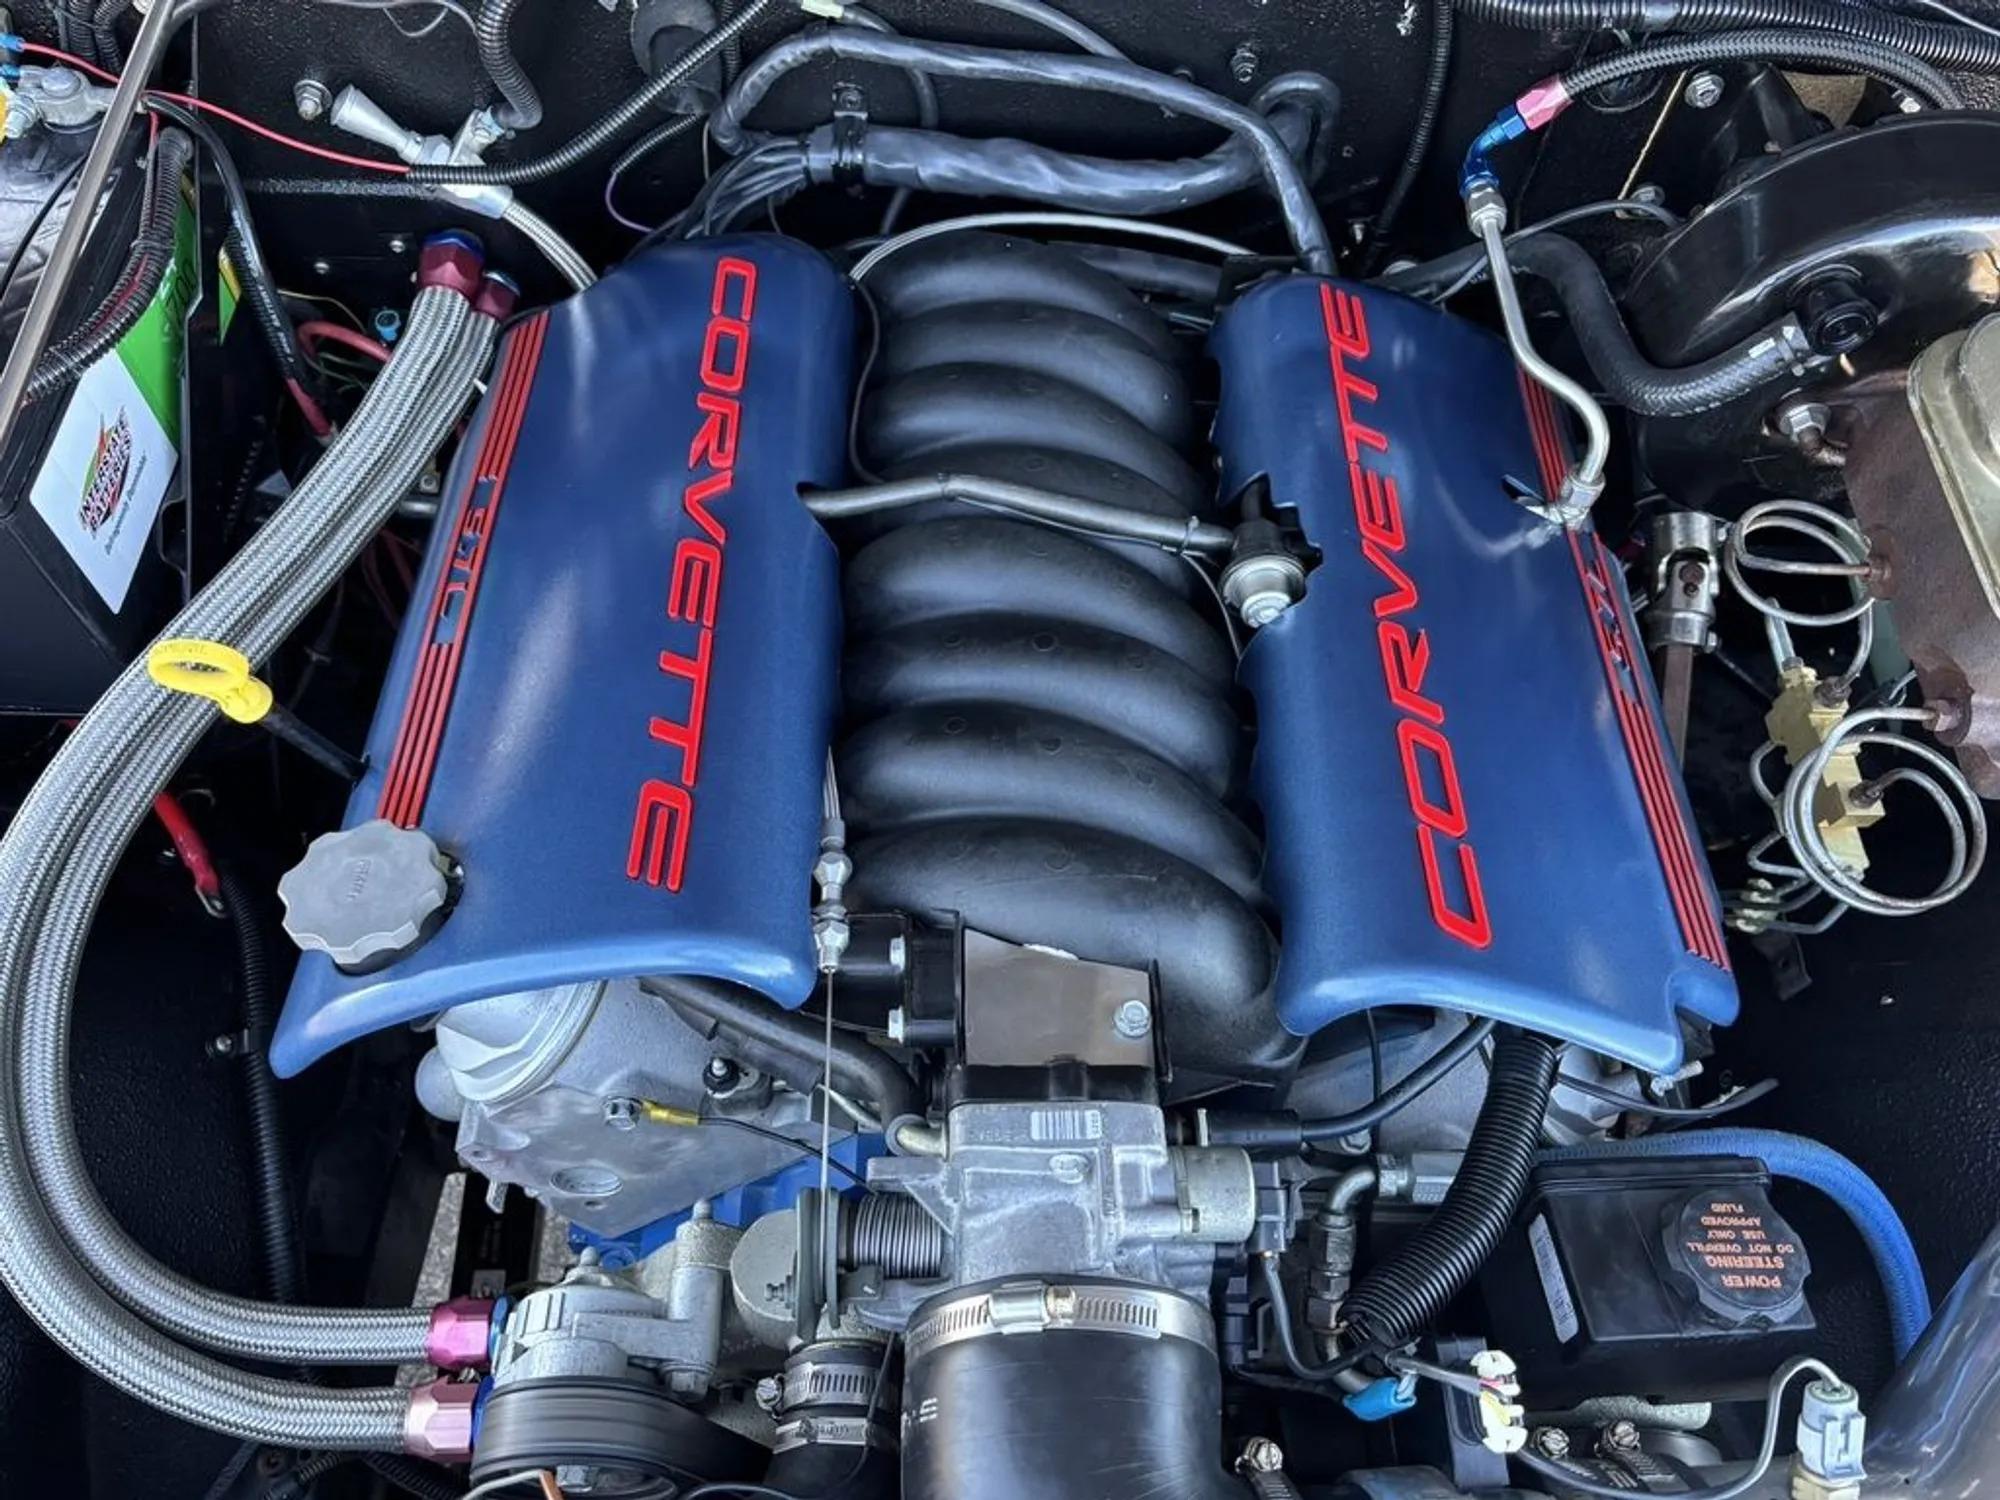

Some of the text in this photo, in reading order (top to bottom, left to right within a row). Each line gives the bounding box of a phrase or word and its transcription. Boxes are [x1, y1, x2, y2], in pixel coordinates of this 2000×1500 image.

[626, 256, 757, 892] CORVETTE
[1320, 282, 1491, 949] CORVETTE
[1711, 1203, 1744, 1214] FLUID
[1701, 1216, 1761, 1227] APPROVED
[1708, 1230, 1767, 1240] USE ONLY
[1686, 1242, 1795, 1254] DO NOT OVERFILL
[1704, 1255, 1785, 1269] STEERING
[1721, 1275, 1782, 1288] POWER
